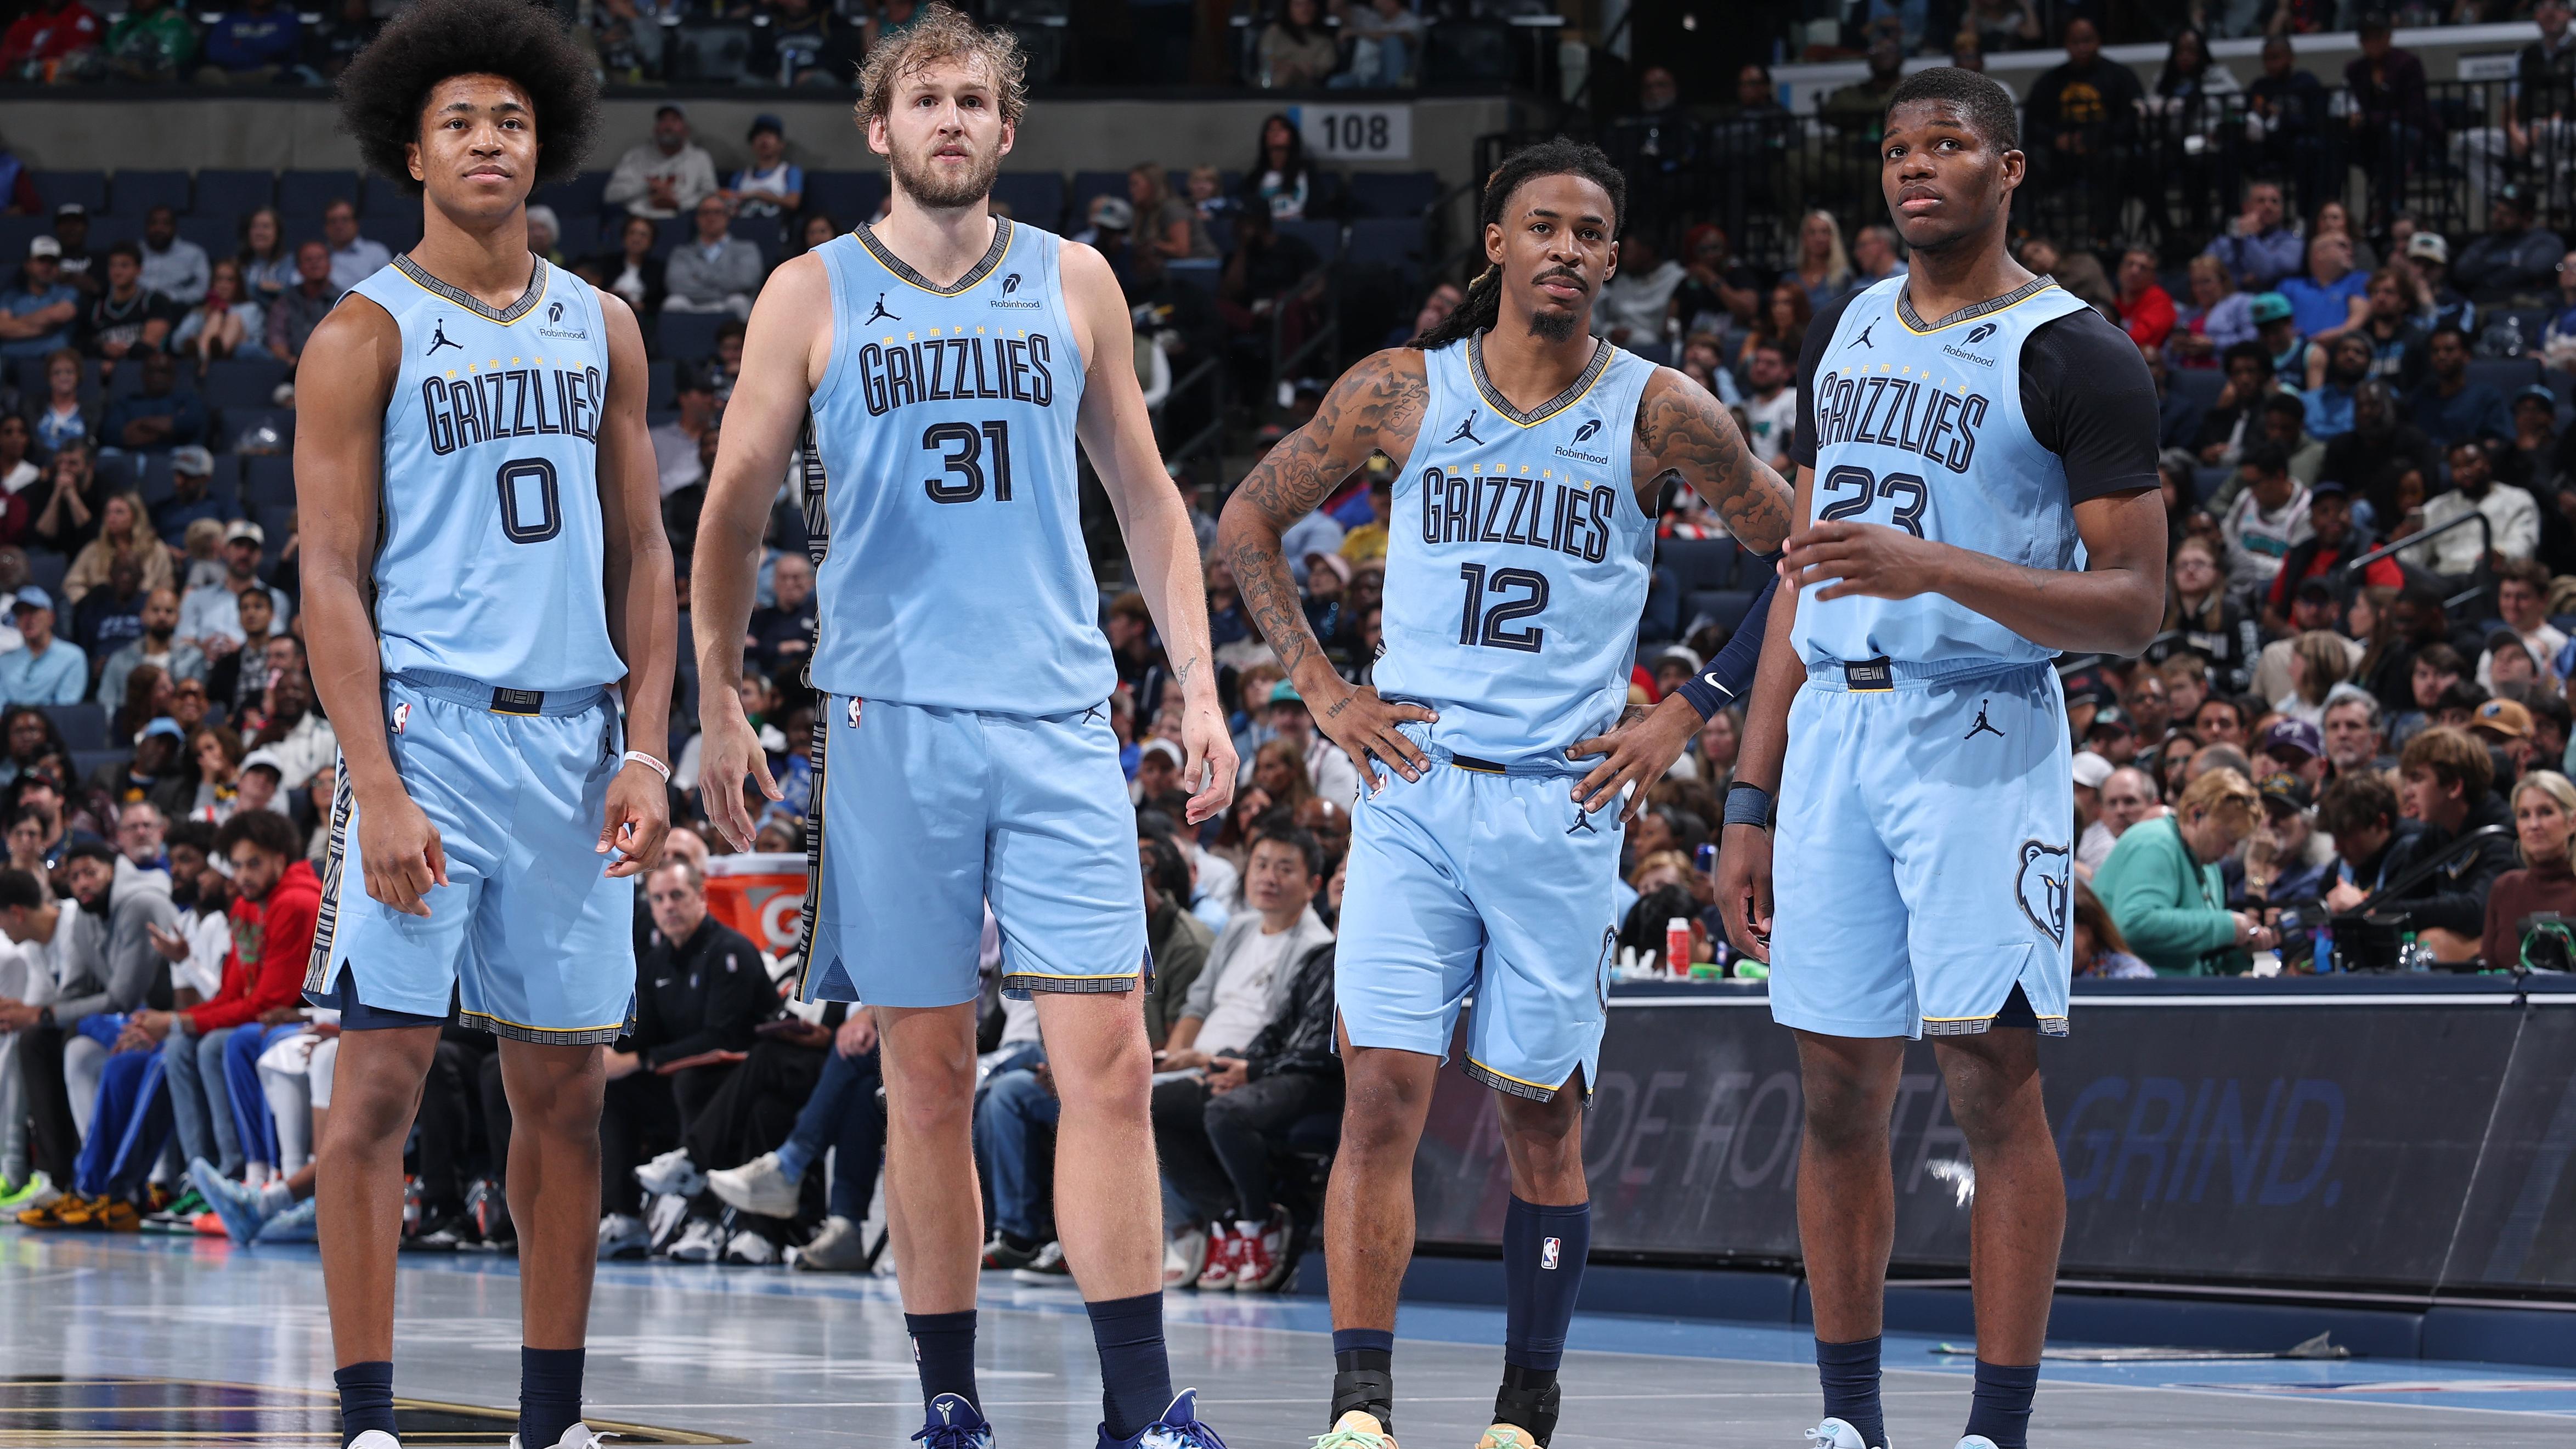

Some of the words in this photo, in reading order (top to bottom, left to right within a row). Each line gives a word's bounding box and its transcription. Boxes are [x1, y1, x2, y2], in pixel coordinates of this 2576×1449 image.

[1321, 112, 1389, 151] 108
[990, 299, 1040, 309] Robinhood
[539, 328, 586, 339] Robinhood
[883, 325, 1026, 345] MEMPHIS
[1942, 344, 1995, 367] Robinhood
[445, 356, 583, 380] MEMPHIS
[858, 333, 1053, 417] GRIZZLIES
[1840, 363, 1968, 395] MEMPHIS
[422, 366, 601, 456] GRIZZLIES
[1817, 371, 1990, 474] GRIZZLIES
[922, 420, 1012, 504] 31
[1447, 463, 1592, 490] MEMPHIS
[1554, 446, 1608, 465] Robinhood
[496, 457, 562, 544] 0
[1422, 467, 1616, 564] GRIZZLIES
[1818, 465, 1928, 541] 23
[1459, 562, 1550, 654] 12
[761, 893, 804, 948] G
[1682, 1071, 1806, 1191] FO
[2056, 1076, 2346, 1207] GRIND.
